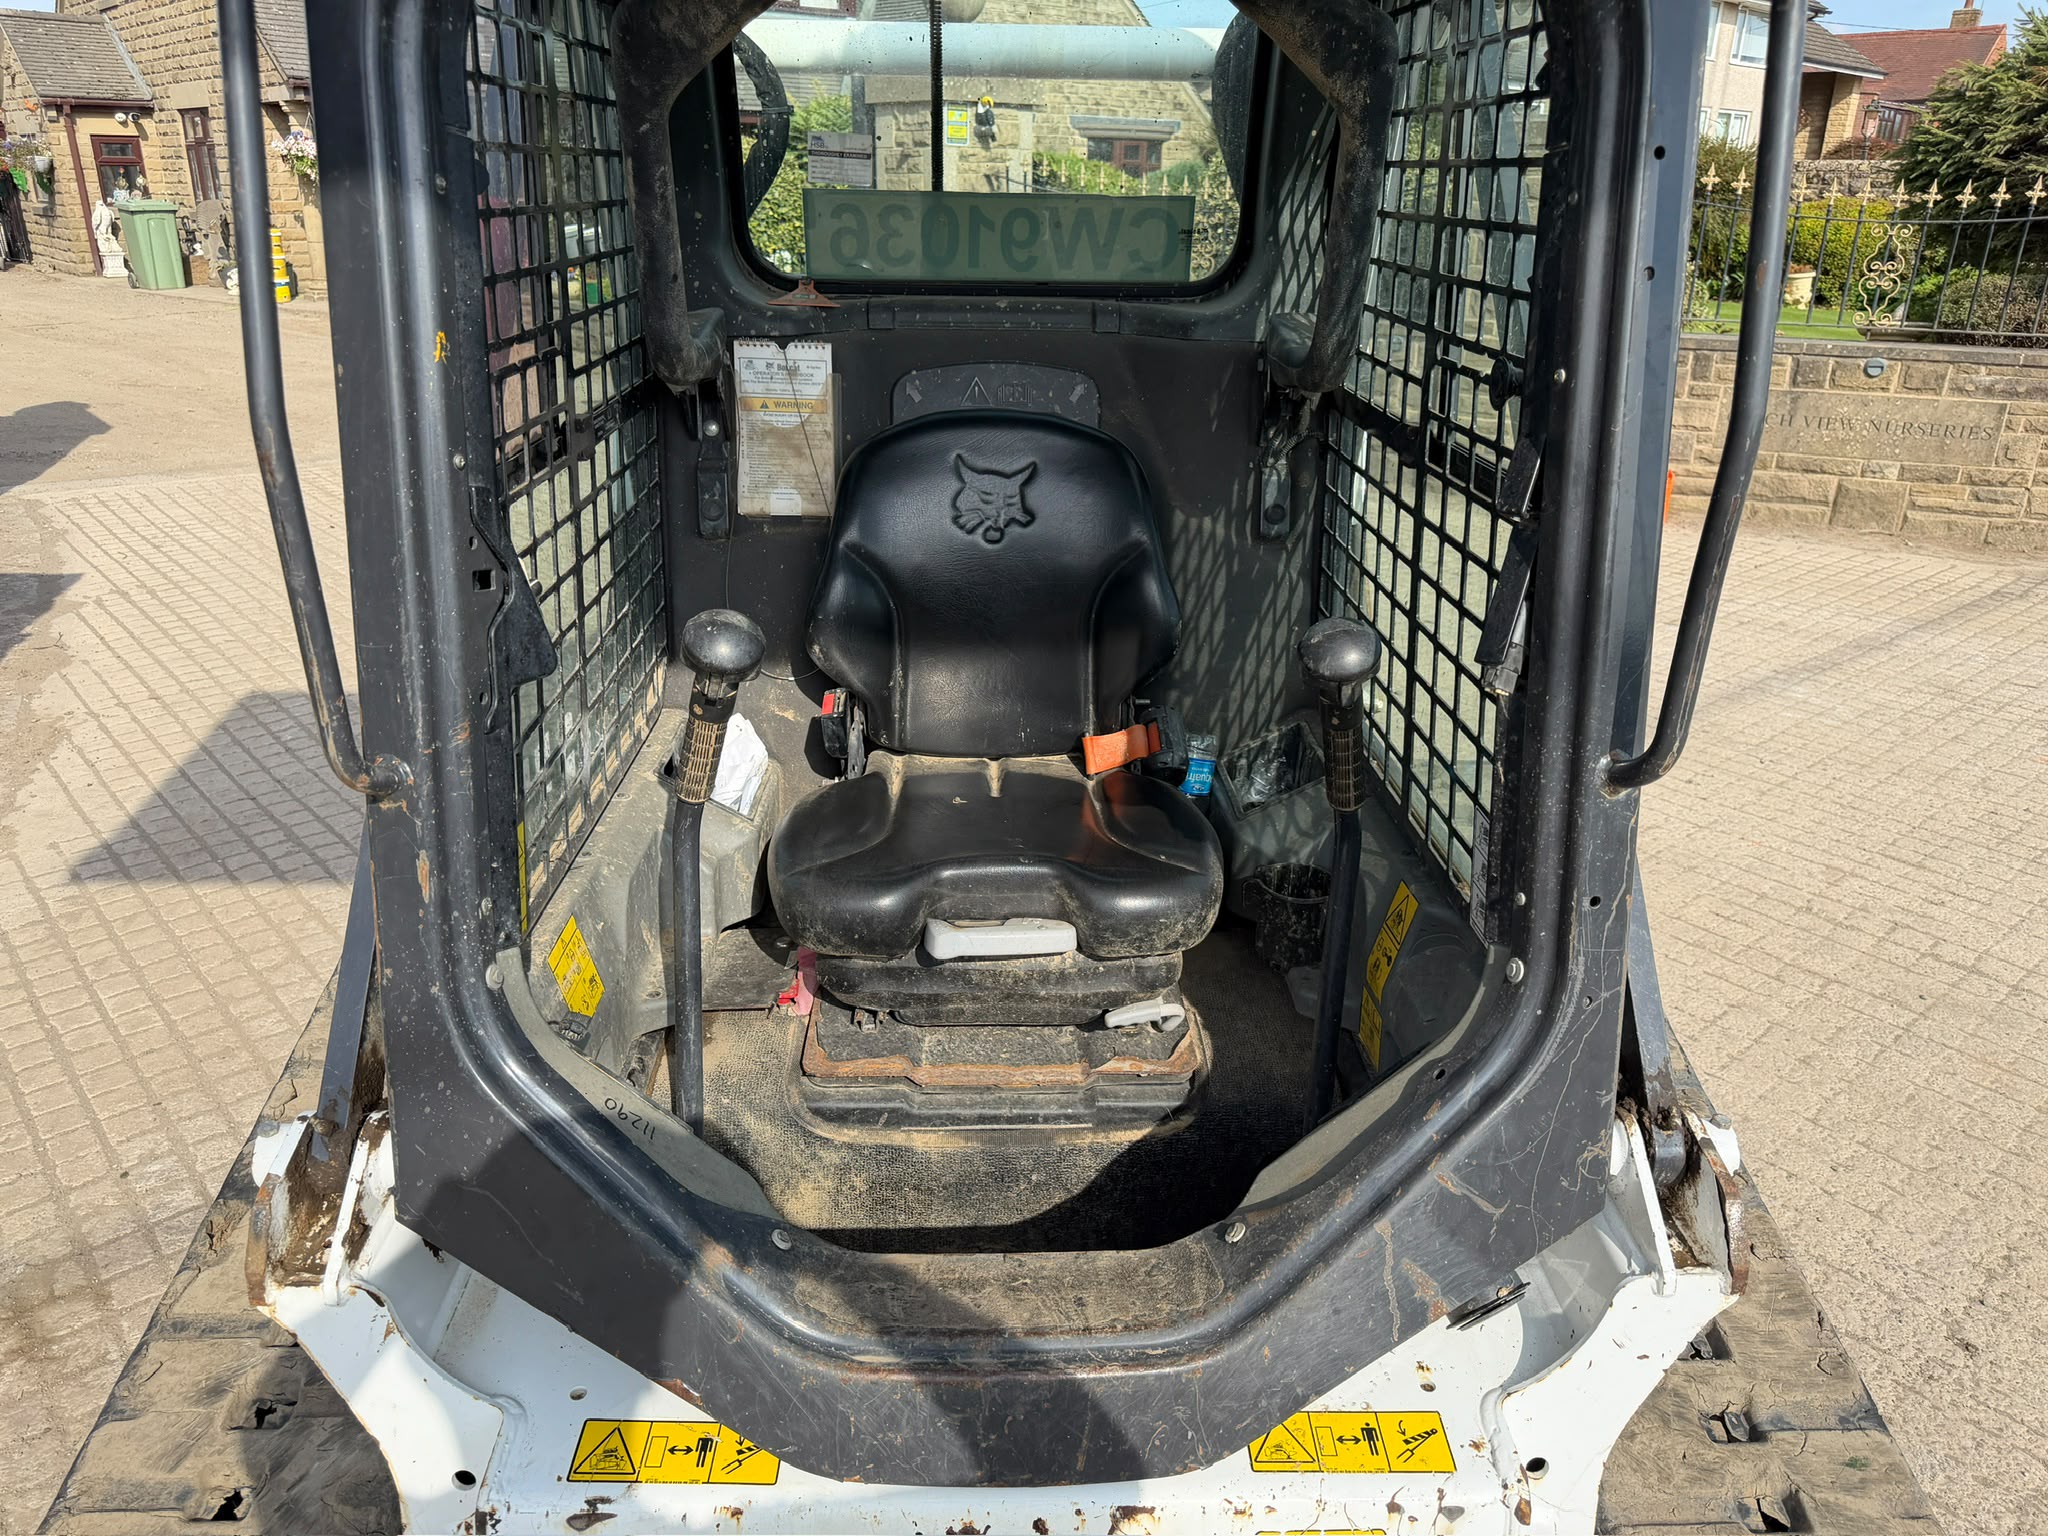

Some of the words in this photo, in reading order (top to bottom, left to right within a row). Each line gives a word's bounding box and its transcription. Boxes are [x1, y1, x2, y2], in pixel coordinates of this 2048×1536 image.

[773, 400, 814, 409] WARNING
[1803, 415, 1860, 431] VIEW
[1868, 418, 1994, 441] NURSERIES
[604, 1097, 656, 1140] 11290
